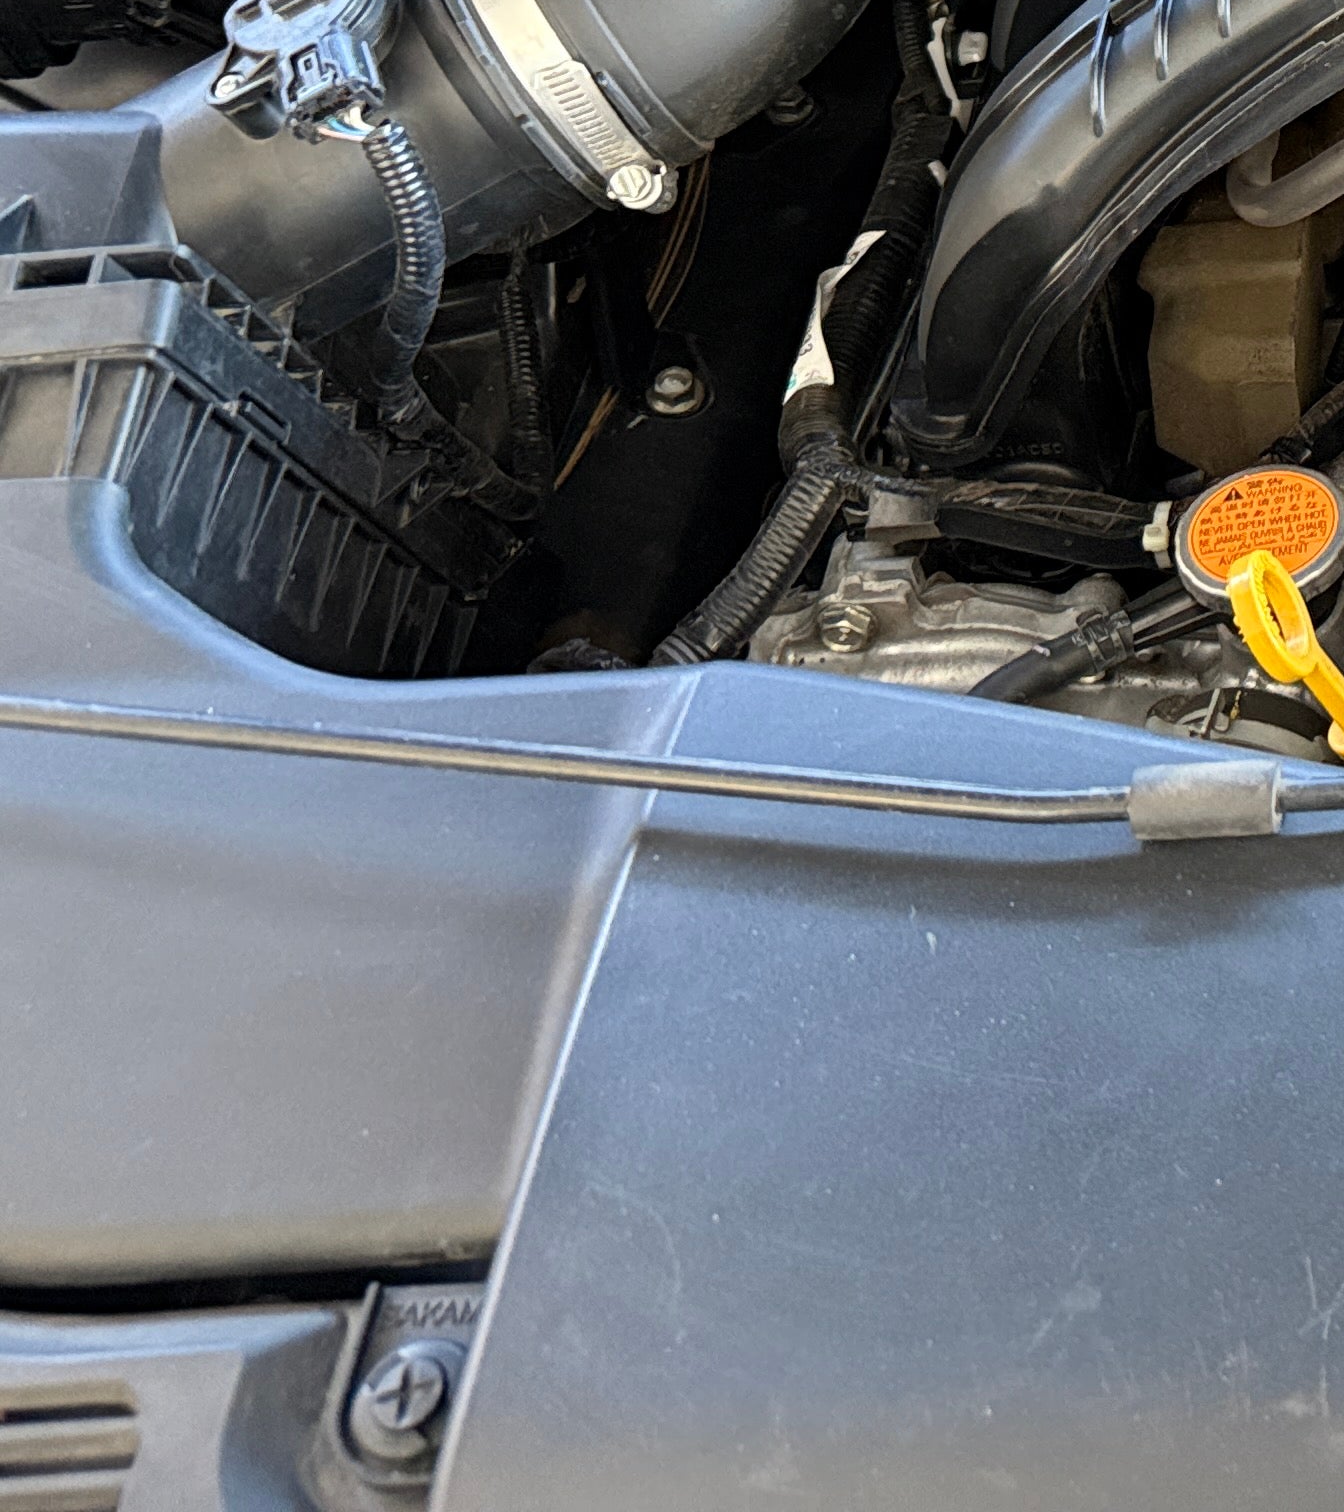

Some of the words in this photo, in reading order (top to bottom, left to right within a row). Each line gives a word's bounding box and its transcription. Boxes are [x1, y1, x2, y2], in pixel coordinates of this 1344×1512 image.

[1246, 482, 1303, 499] WARNING
[1199, 523, 1234, 537] NEVER
[1237, 519, 1266, 531] OPEN
[1269, 513, 1302, 526] WHEN
